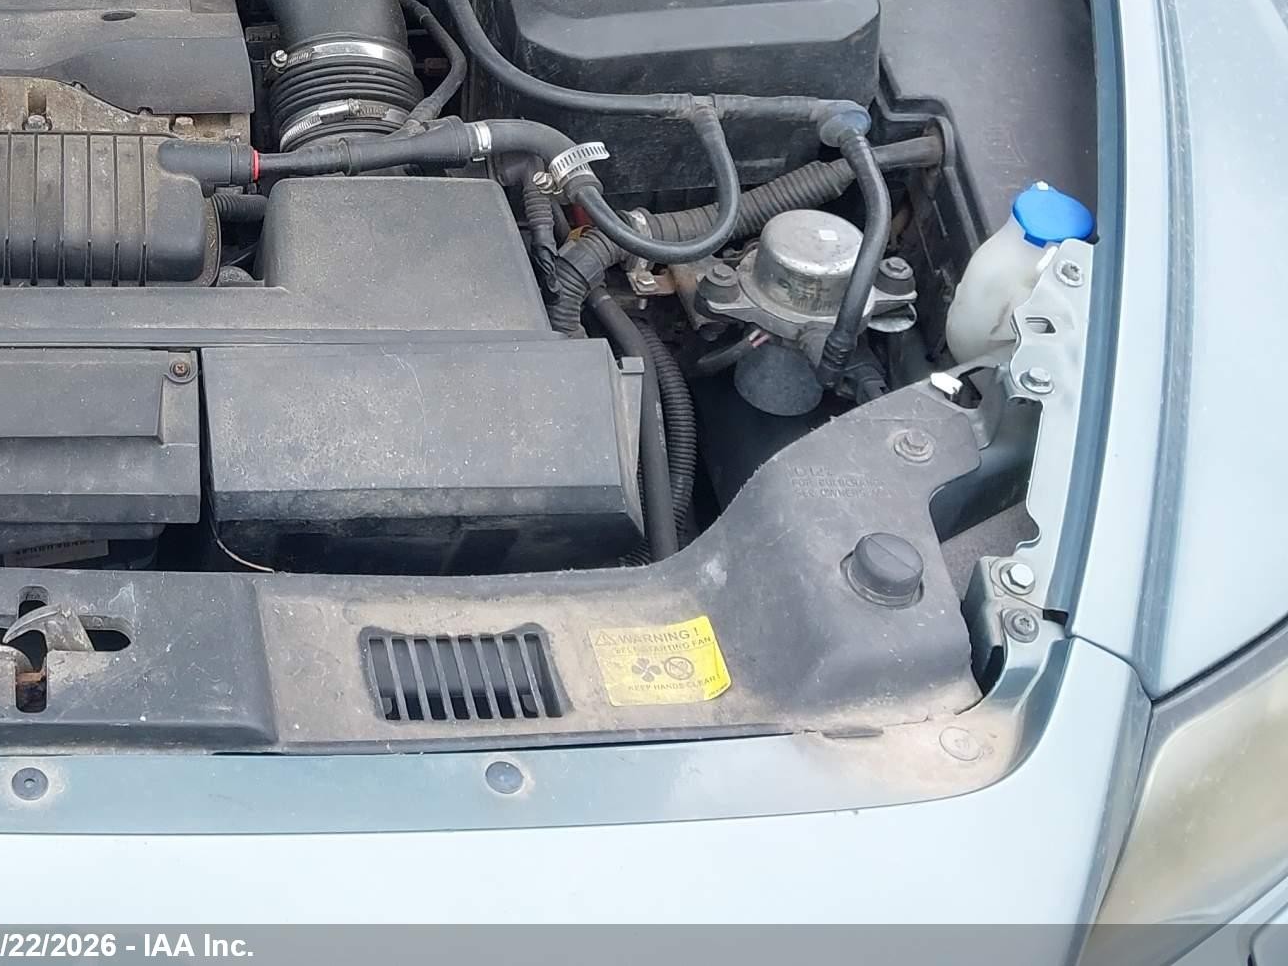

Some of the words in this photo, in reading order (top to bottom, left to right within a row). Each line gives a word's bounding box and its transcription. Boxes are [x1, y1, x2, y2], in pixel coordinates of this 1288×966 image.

[617, 629, 690, 644] WARNING
[691, 636, 711, 647] FAN
[654, 683, 683, 691] HANDS
